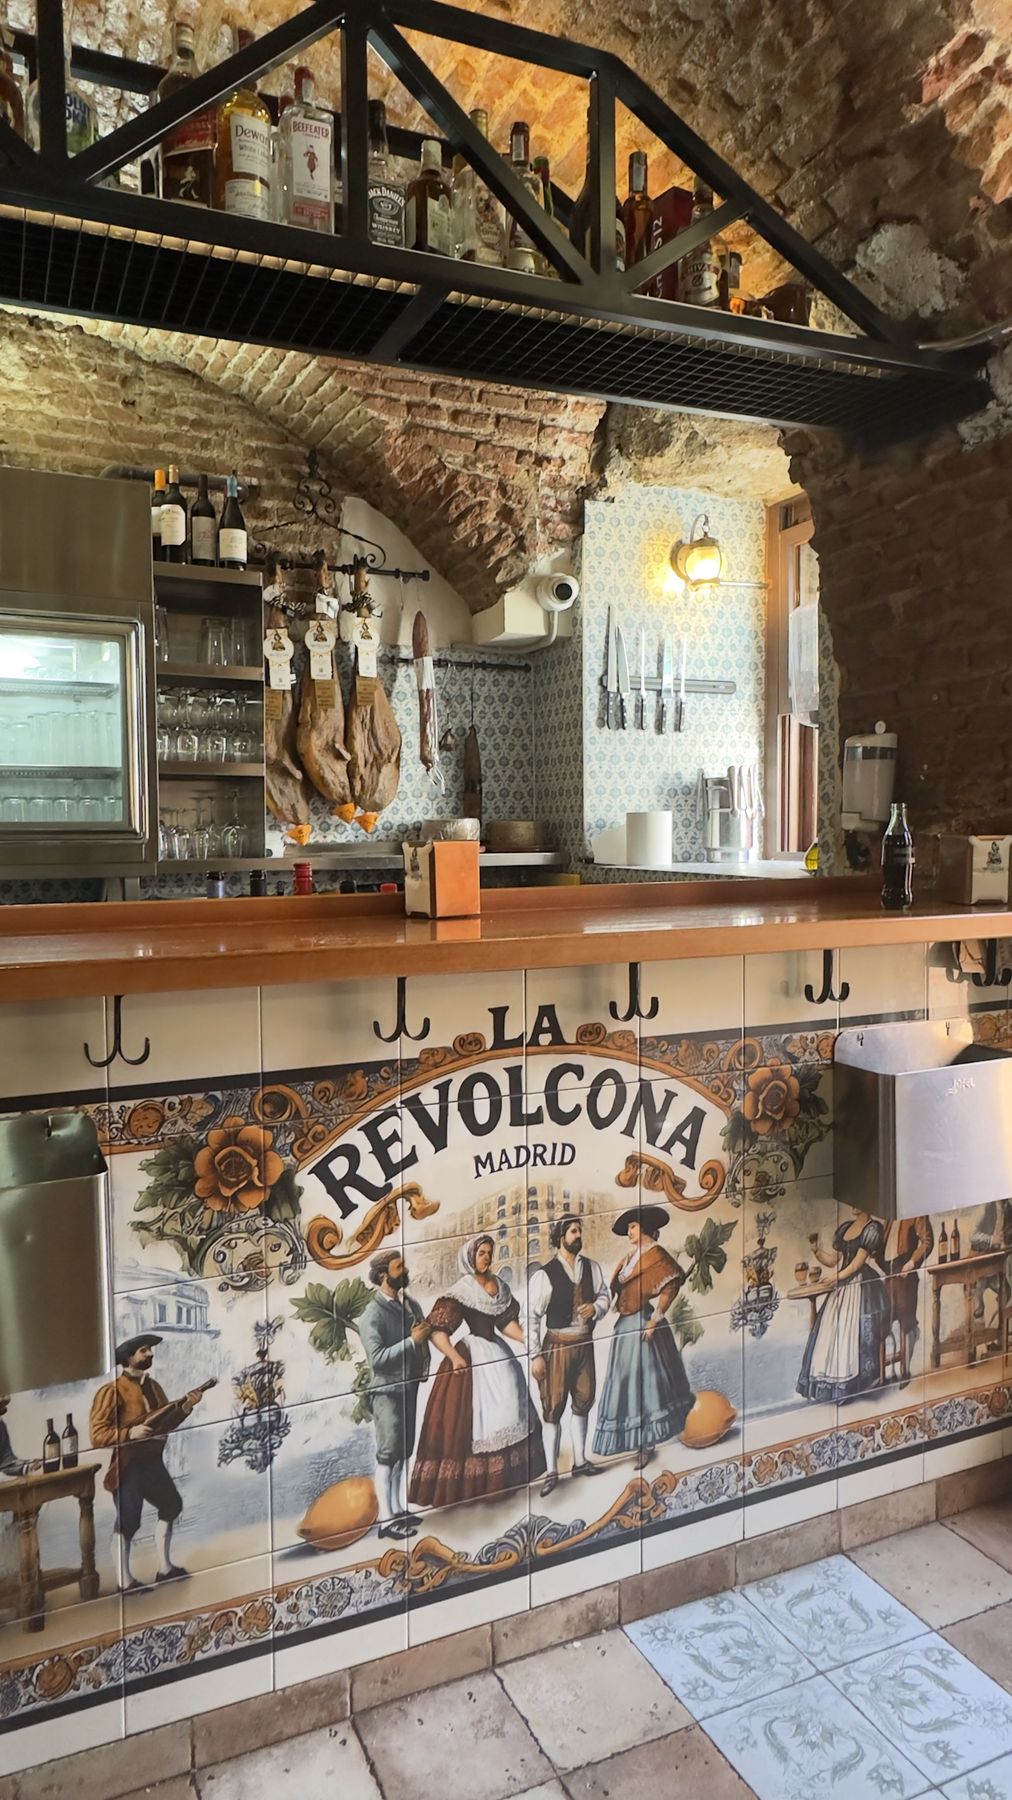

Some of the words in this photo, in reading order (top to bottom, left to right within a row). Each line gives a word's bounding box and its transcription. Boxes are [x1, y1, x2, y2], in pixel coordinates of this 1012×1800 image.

[292, 120, 330, 139] BEEFEATER
[368, 186, 382, 199] JACK
[487, 1003, 567, 1052] LA
[309, 1062, 708, 1220] REVOLCONA
[473, 1142, 577, 1179] MADRID
